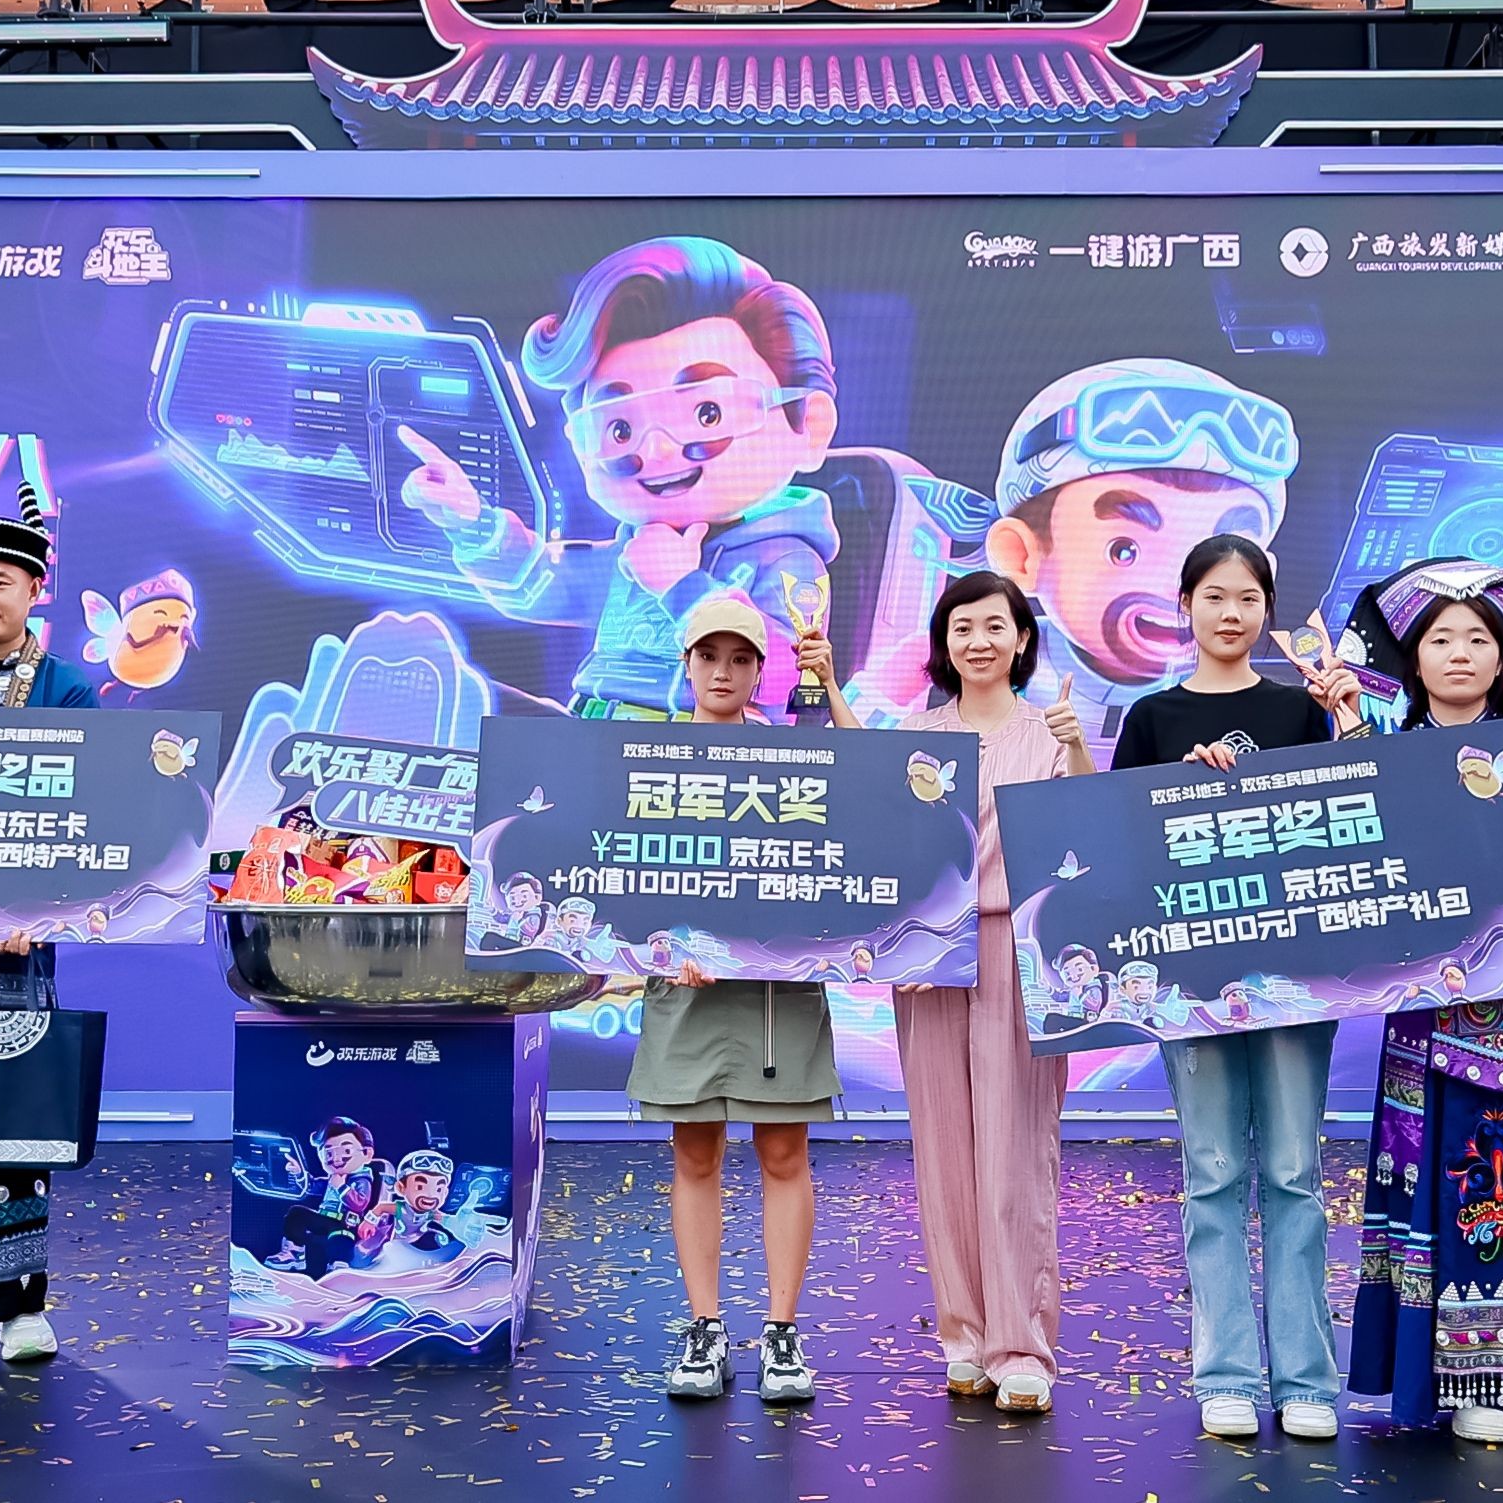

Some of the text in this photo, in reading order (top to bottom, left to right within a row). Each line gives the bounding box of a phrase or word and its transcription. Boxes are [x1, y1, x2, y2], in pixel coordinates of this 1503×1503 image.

[1049, 233, 1240, 268] 一键游广西
[1356, 262, 1397, 271] GUANGXI
[1398, 262, 1439, 271] TOURISM
[626, 770, 829, 826] 冠军大奖
[590, 830, 844, 870] ¥3000 京东E卡
[1163, 792, 1384, 868] 季军奖品
[548, 867, 900, 907] +价值1000元广西特产礼包
[1153, 857, 1408, 918] ¥800 京东E卡
[1107, 886, 1472, 959] +价值200元广西特产礼包
[336, 1047, 398, 1062] 欢乐游戏
